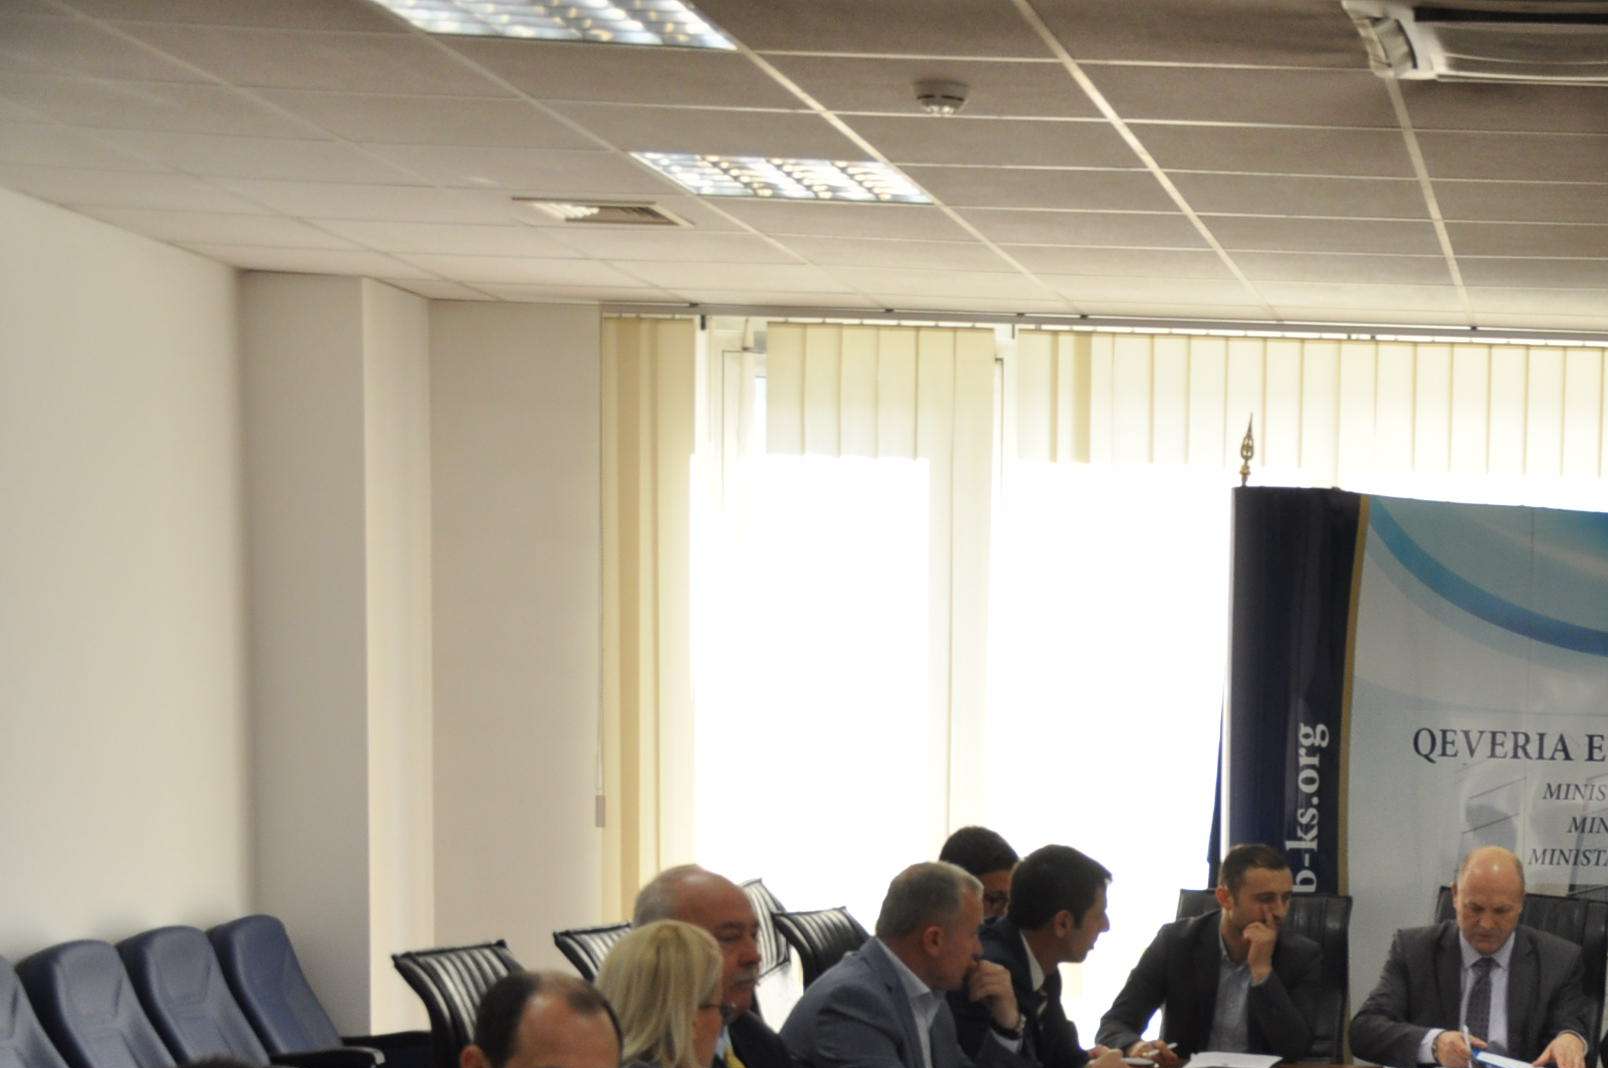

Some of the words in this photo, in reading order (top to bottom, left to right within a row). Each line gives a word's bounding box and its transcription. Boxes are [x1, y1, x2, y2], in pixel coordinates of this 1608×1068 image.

[1412, 727, 1574, 764] QEVERIA
[1584, 733, 1606, 763] E
[1285, 722, 1330, 893] b-ks.org
